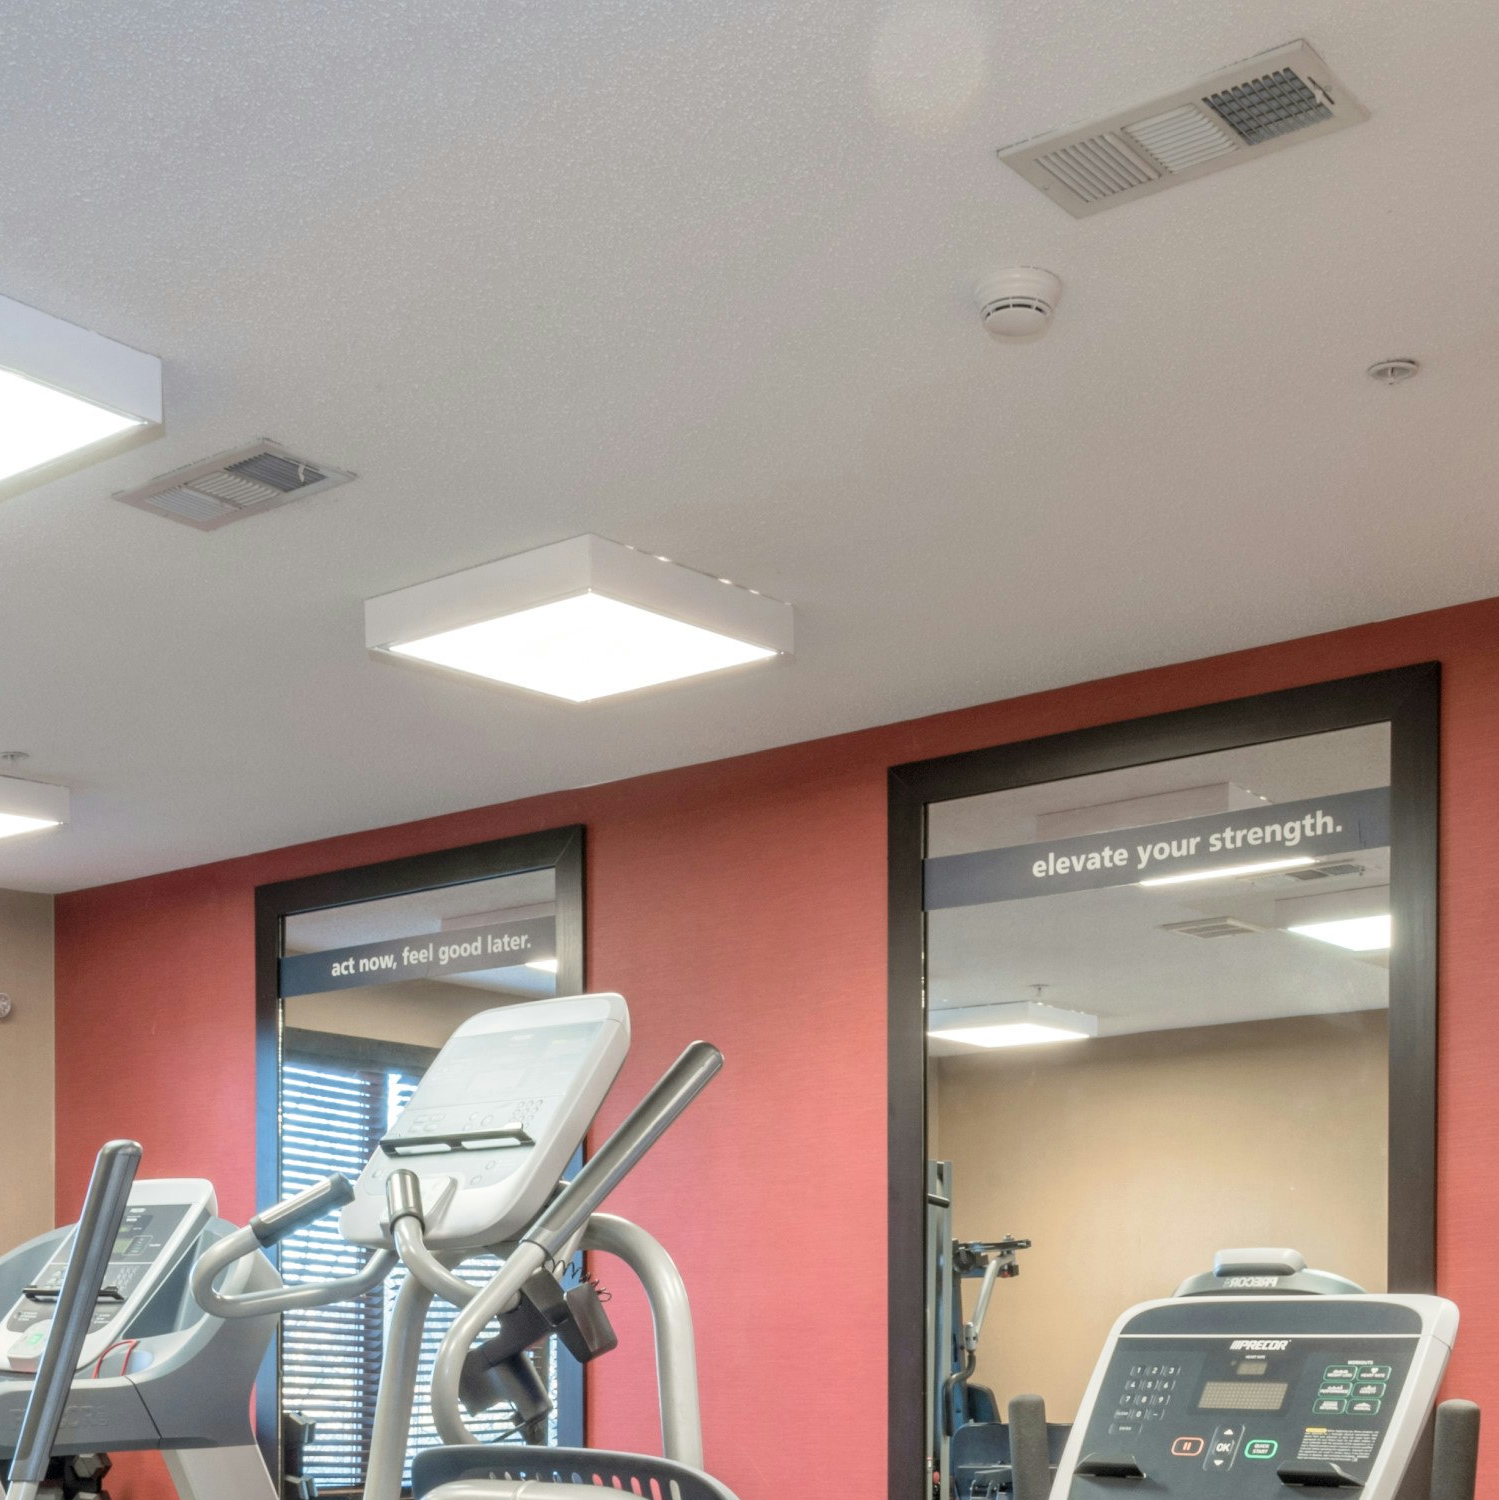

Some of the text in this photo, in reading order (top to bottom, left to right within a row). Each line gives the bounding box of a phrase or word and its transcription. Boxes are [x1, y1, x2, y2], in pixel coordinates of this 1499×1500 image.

[1031, 810, 1343, 878] elevate your strength.
[330, 934, 531, 977] act now, feel good later.
[1235, 1340, 1288, 1351] PRECOR
[1216, 1443, 1231, 1452] OK
